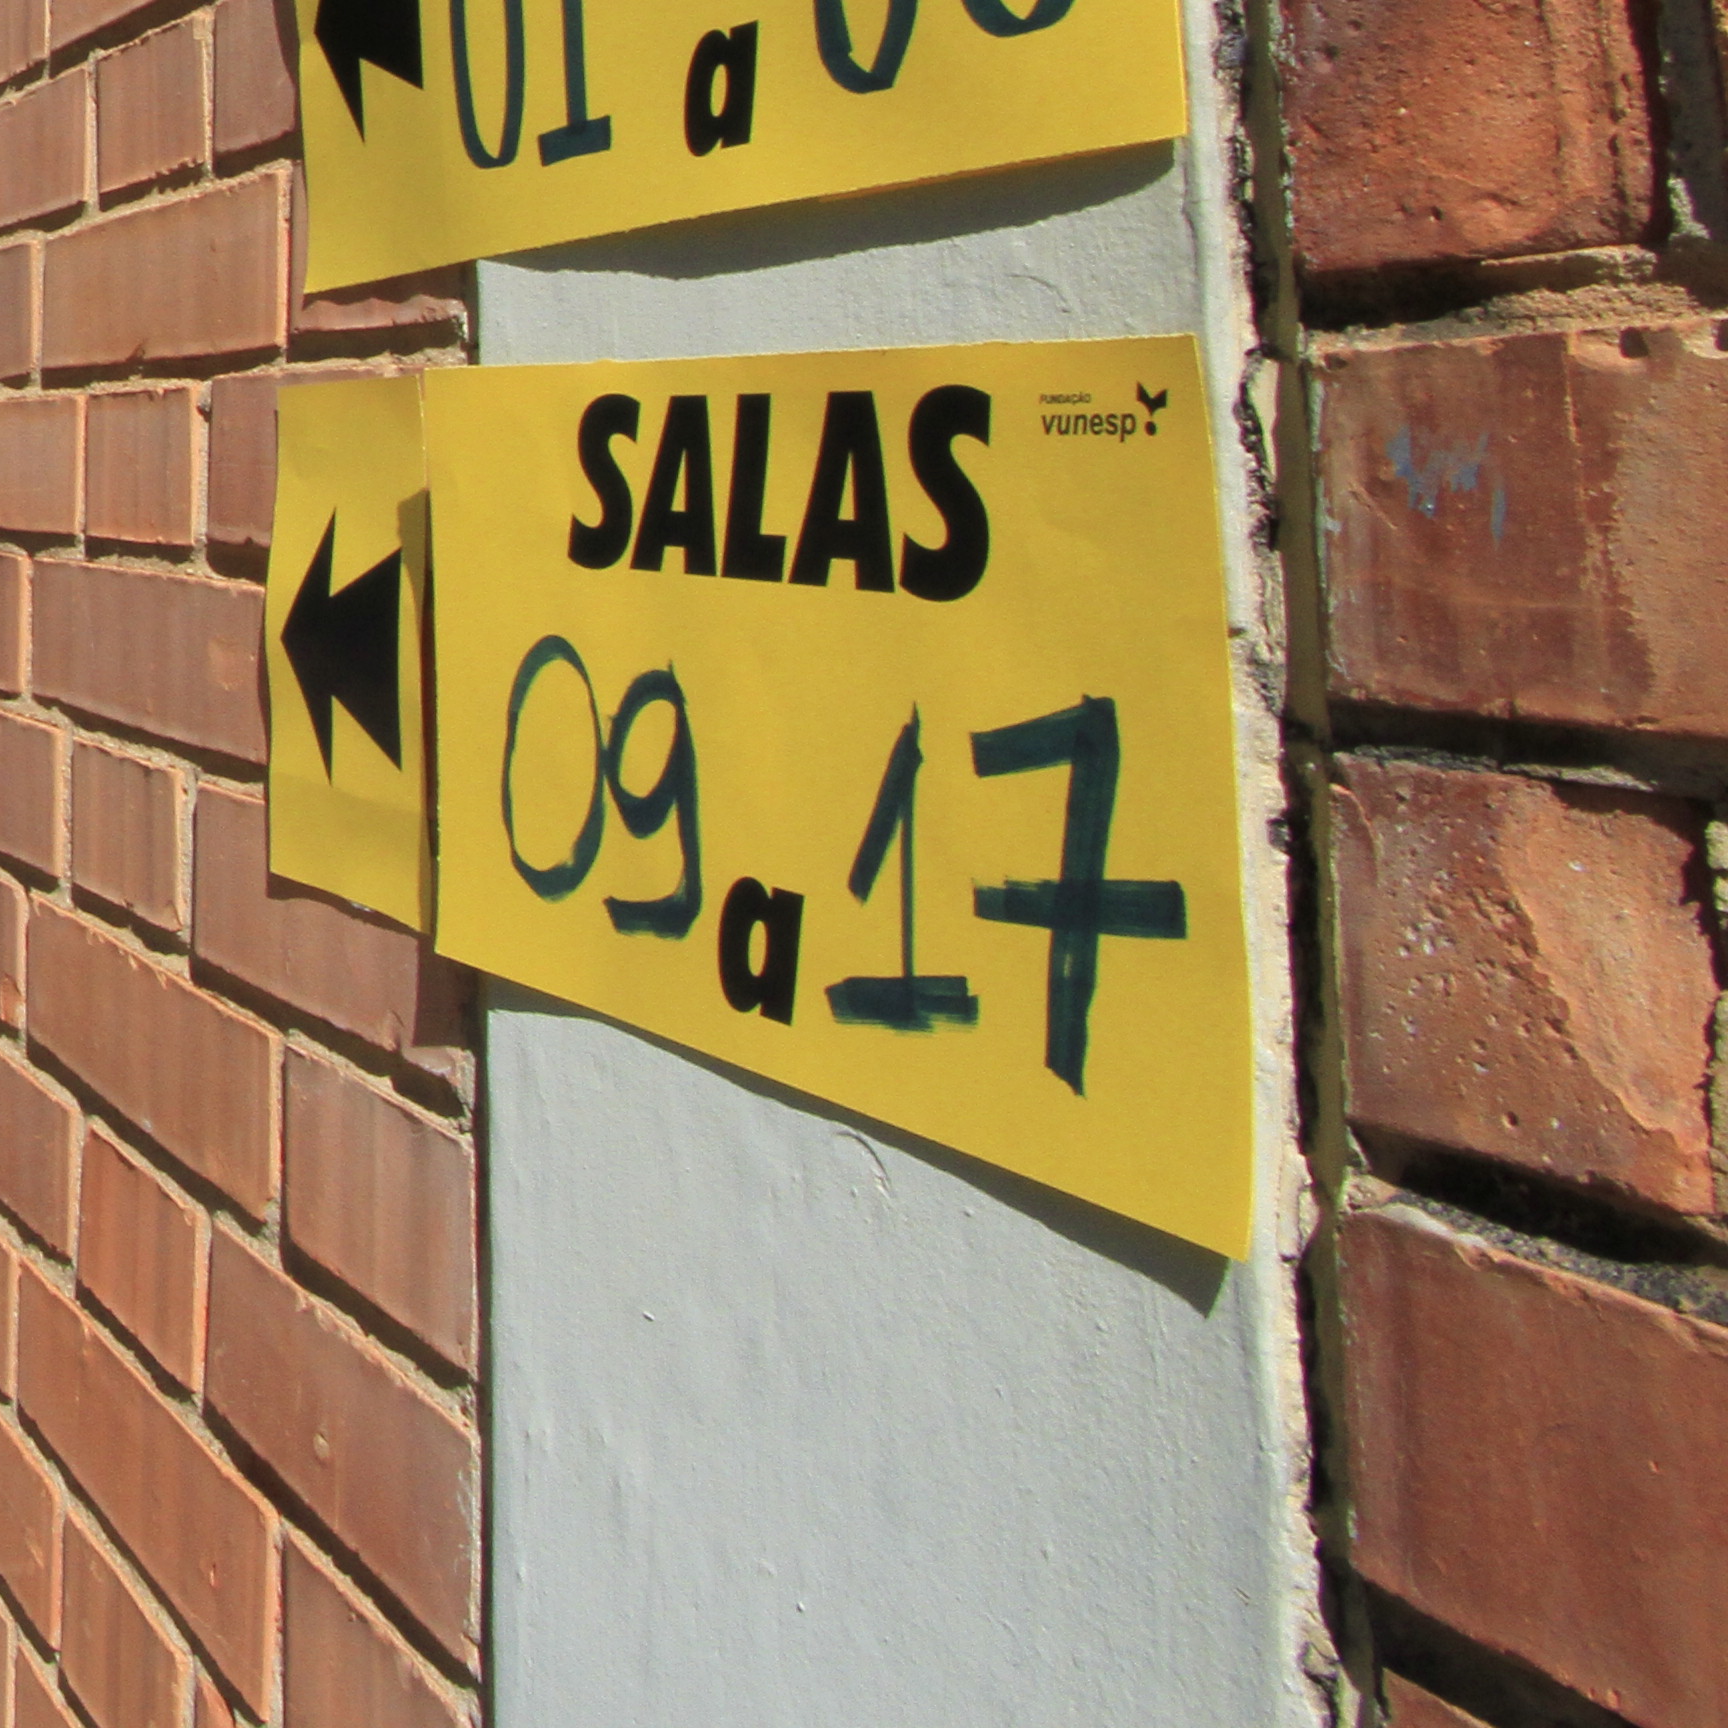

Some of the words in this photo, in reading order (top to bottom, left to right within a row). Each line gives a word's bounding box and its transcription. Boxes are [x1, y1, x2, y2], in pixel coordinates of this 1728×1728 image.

[684, 20, 758, 157] a
[568, 384, 992, 603] SALAS
[1041, 413, 1136, 443] vunesp
[502, 635, 703, 940] 09
[718, 876, 805, 1026] a
[824, 694, 1188, 1098] 17
